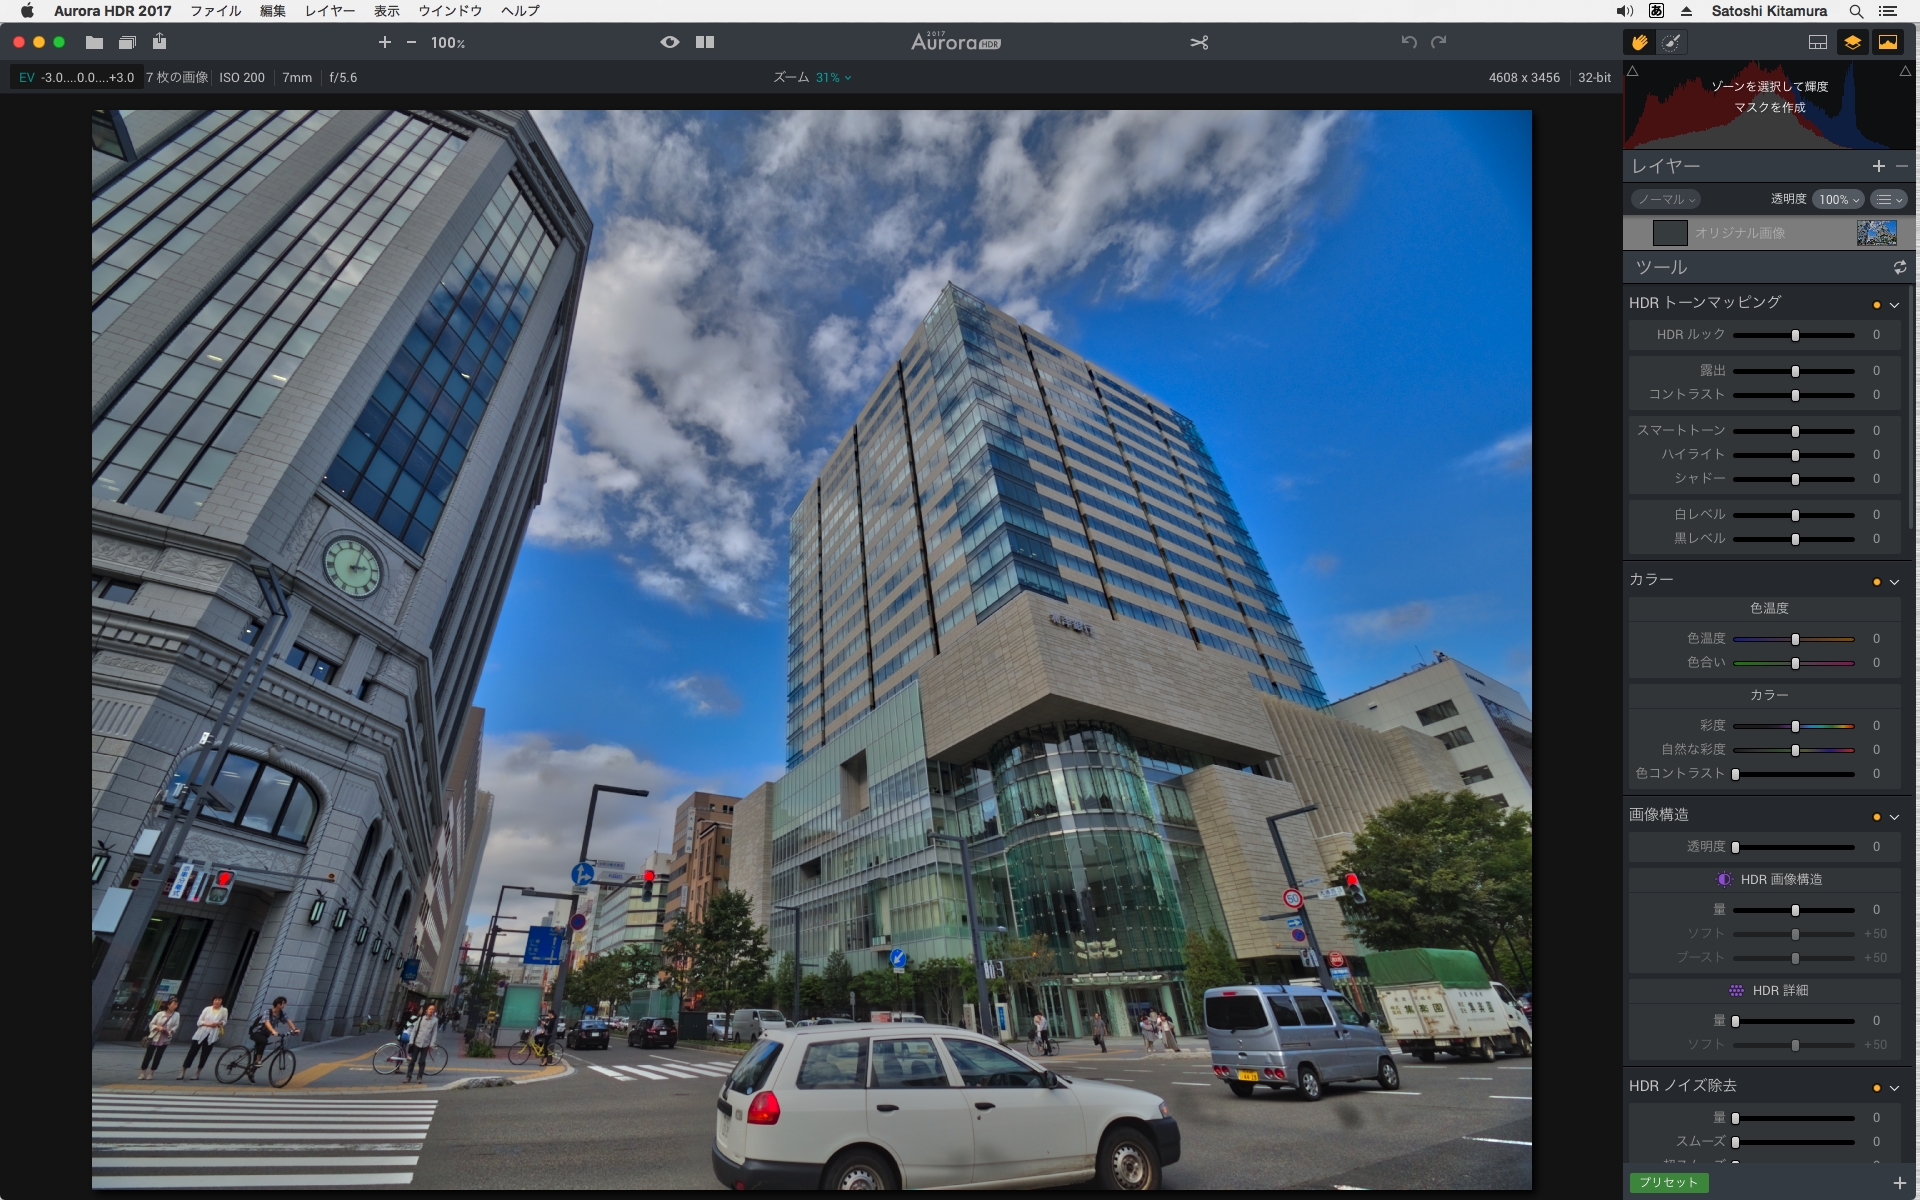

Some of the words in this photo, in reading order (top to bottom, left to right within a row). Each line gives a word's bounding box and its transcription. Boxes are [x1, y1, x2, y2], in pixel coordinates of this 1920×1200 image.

[53, 5, 101, 17] Aurora
[104, 5, 135, 17] HDR
[138, 4, 172, 17] 2017
[191, 4, 242, 17] ファイル
[259, 4, 286, 18] 編集
[306, 4, 356, 18] レイヤー
[374, 4, 401, 18] 表示
[419, 4, 482, 17] ウインドウ
[501, 4, 541, 17] ヘルプ
[1711, 4, 1763, 17] Satoshi
[1767, 4, 1829, 17] Kitamura
[431, 36, 466, 49] 100%
[911, 32, 977, 50] Aurora
[19, 71, 36, 83] EV
[145, 72, 154, 83] 7
[156, 70, 209, 84] 枚の画像
[219, 71, 240, 83] ISO
[243, 71, 265, 83] 200
[282, 72, 313, 83] 7mm
[329, 71, 358, 84] f/5.6
[773, 70, 810, 83] ズーム
[816, 71, 841, 83] 31%
[1488, 71, 1518, 83] 4608
[1521, 74, 1528, 83] x
[1531, 71, 1561, 83] 3456
[1578, 71, 1612, 83] 32-bit
[1711, 80, 1829, 94] ゾーンを選択して輝度
[1734, 101, 1806, 115] マスクを作成
[1633, 157, 1701, 175] レイヤー
[1639, 194, 1685, 205] ノーマル
[1771, 192, 1807, 205] 透明度
[1819, 194, 1849, 205] 100%
[1695, 226, 1786, 240] オリジナル画像
[1636, 259, 1688, 276] ツール
[1629, 296, 1660, 309] HDR
[1666, 294, 1782, 310] トーンマッピング
[1657, 329, 1684, 340] HDR
[1687, 327, 1725, 341] ルック
[1873, 328, 1881, 340] 0
[1700, 363, 1726, 377] 露出
[1873, 364, 1881, 376] 0
[1649, 387, 1725, 401] コントラスト
[1873, 388, 1881, 400] 0
[1637, 423, 1726, 437] スマートトーン
[1873, 424, 1881, 436] 0
[1661, 447, 1725, 461] ハイライト
[1873, 448, 1881, 460] 0
[1675, 471, 1726, 485] シャドー
[1873, 472, 1881, 484] 0
[1675, 507, 1726, 521] 白レベル
[1873, 508, 1881, 520] 0
[1674, 531, 1726, 545] 黒レベル
[1873, 532, 1881, 544] 0
[1630, 572, 1674, 586] カラー
[1750, 601, 1789, 615] 色温度
[1687, 631, 1726, 645] 色温度
[1873, 632, 1881, 644] 0
[1687, 655, 1726, 669] 色合い
[1873, 656, 1881, 668] 0
[1750, 688, 1789, 701] カラー
[1700, 718, 1726, 732] 彩度
[1873, 719, 1881, 731] 0
[1662, 742, 1726, 756] 自然な彩度
[1873, 743, 1881, 755] 0
[1635, 766, 1725, 780] 色コントラスト
[1873, 767, 1881, 779] 0
[1629, 806, 1689, 822] 画像構造
[1687, 839, 1726, 853] 透明度
[1873, 840, 1881, 852] 0
[1741, 874, 1768, 885] HDR
[1771, 872, 1823, 886] 画像構造
[1286, 893, 1299, 904] 50
[1713, 902, 1726, 916] 量
[1873, 903, 1881, 915] 0
[1688, 926, 1725, 940] ソフト
[1864, 927, 1888, 939] +50
[1677, 950, 1725, 964] ブースト
[1864, 951, 1888, 963] +50
[1753, 985, 1780, 996] HDR
[1782, 983, 1809, 997] 詳細
[1713, 1013, 1726, 1027] 量
[1873, 1014, 1881, 1026] 0
[1688, 1037, 1725, 1051] ソフト
[1864, 1038, 1888, 1050] +50
[1629, 1079, 1660, 1092] HDR
[1664, 1077, 1738, 1093] ノイズ除去
[1713, 1110, 1726, 1124] 量
[1873, 1111, 1881, 1123] 0
[1676, 1134, 1727, 1147] スムーズ
[1873, 1135, 1881, 1147] 0
[1640, 1176, 1698, 1188] プリセット
